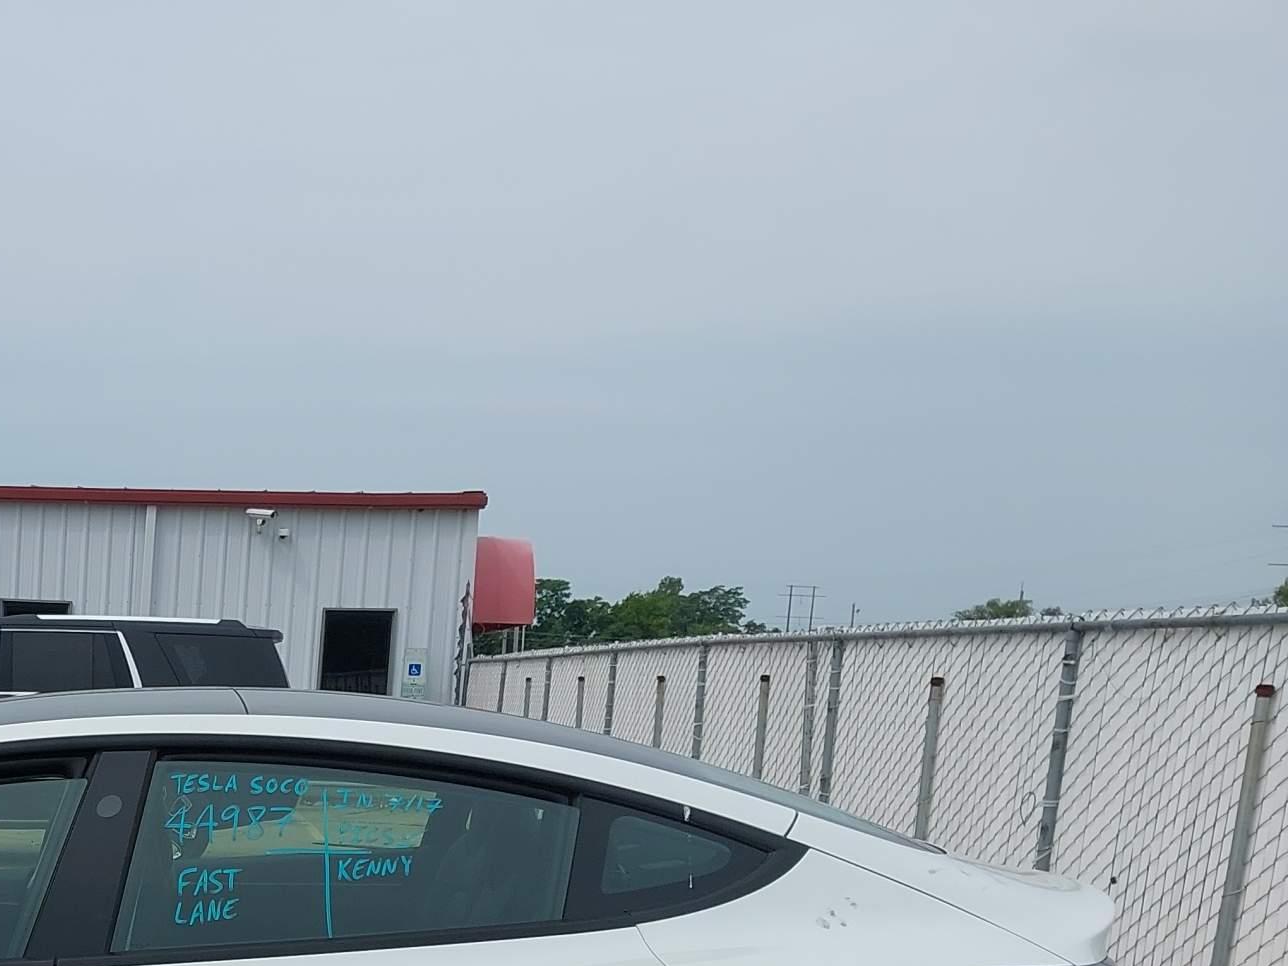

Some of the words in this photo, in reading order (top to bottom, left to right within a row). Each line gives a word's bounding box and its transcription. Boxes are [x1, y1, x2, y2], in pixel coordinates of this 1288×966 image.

[171, 773, 238, 795] TESLA
[164, 803, 297, 844] 44987
[177, 866, 243, 896] FAST
[338, 855, 413, 881] KENNY
[174, 898, 239, 926] LANE
